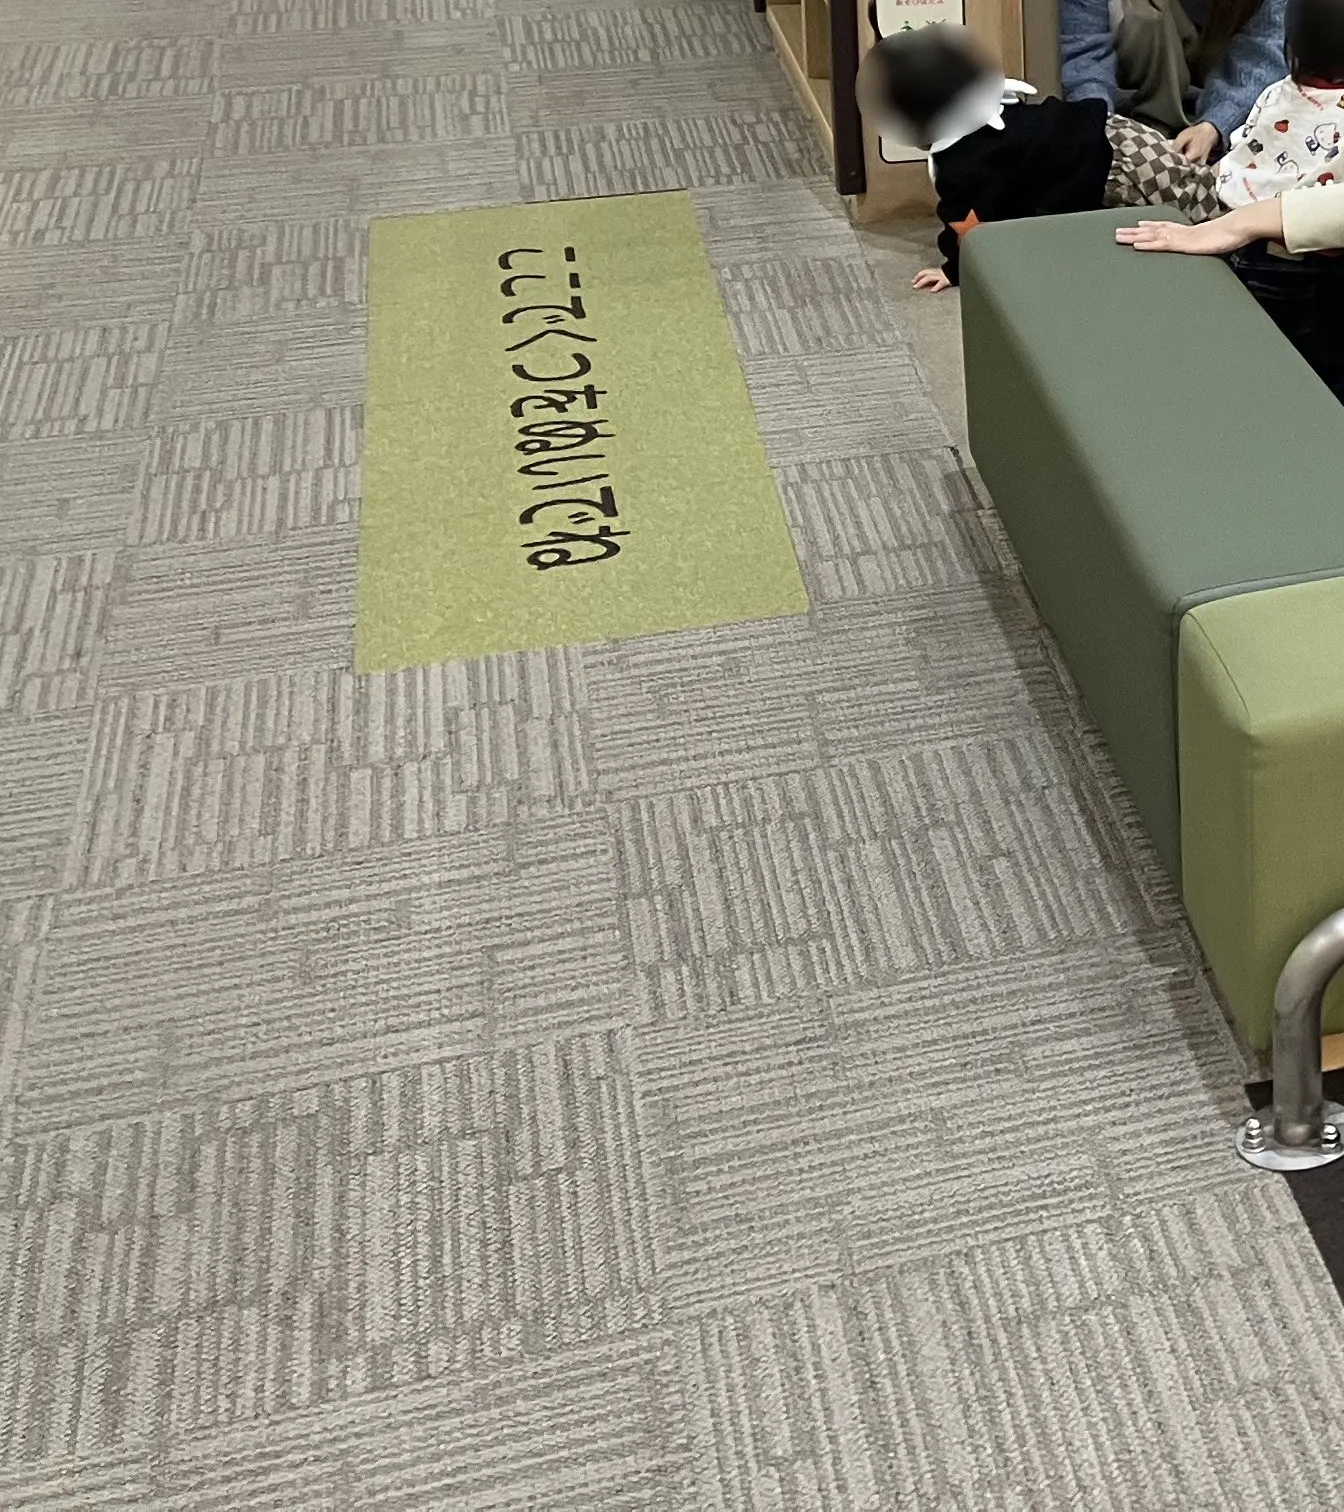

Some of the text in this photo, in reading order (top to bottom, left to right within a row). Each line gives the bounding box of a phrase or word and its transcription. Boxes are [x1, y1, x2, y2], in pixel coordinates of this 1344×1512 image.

[497, 245, 632, 573] ここでくつをぬいでね
